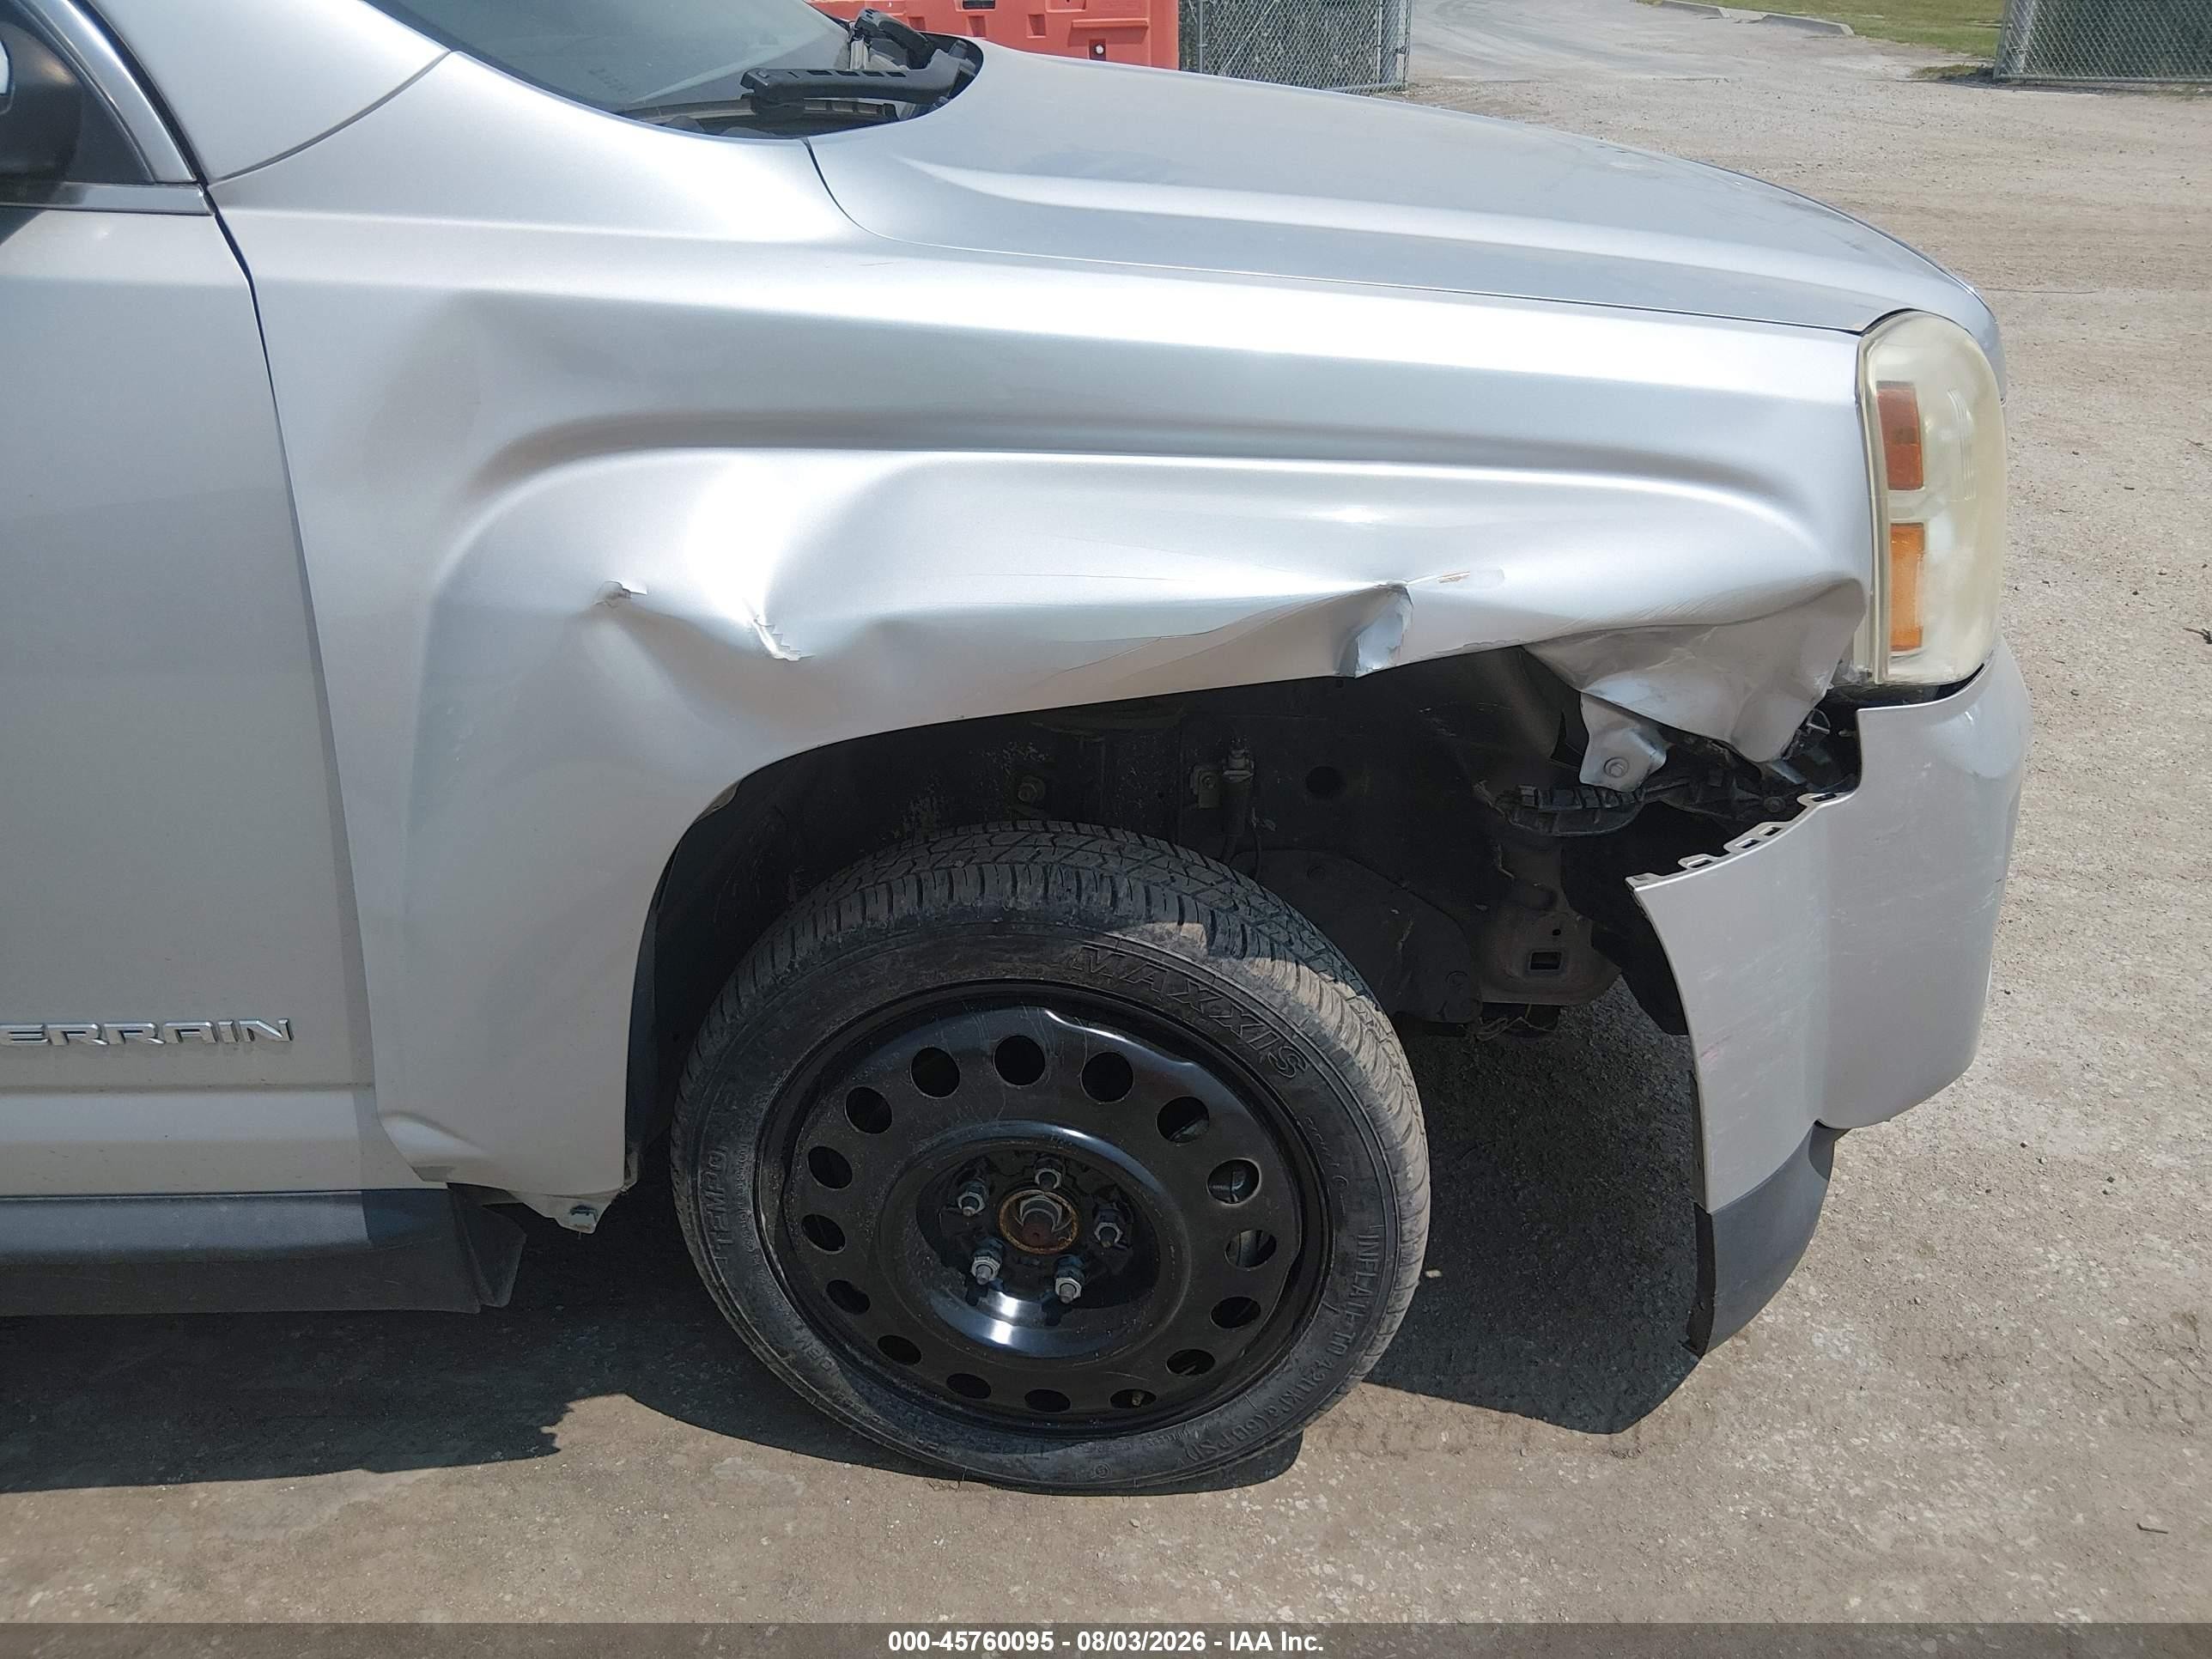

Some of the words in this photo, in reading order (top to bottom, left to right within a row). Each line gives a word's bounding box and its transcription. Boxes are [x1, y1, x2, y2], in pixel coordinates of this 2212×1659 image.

[1072, 943, 1305, 1079] MAXXIS
[1344, 1234, 1380, 1323] INFLATE
[1324, 1328, 1355, 1358] TO
